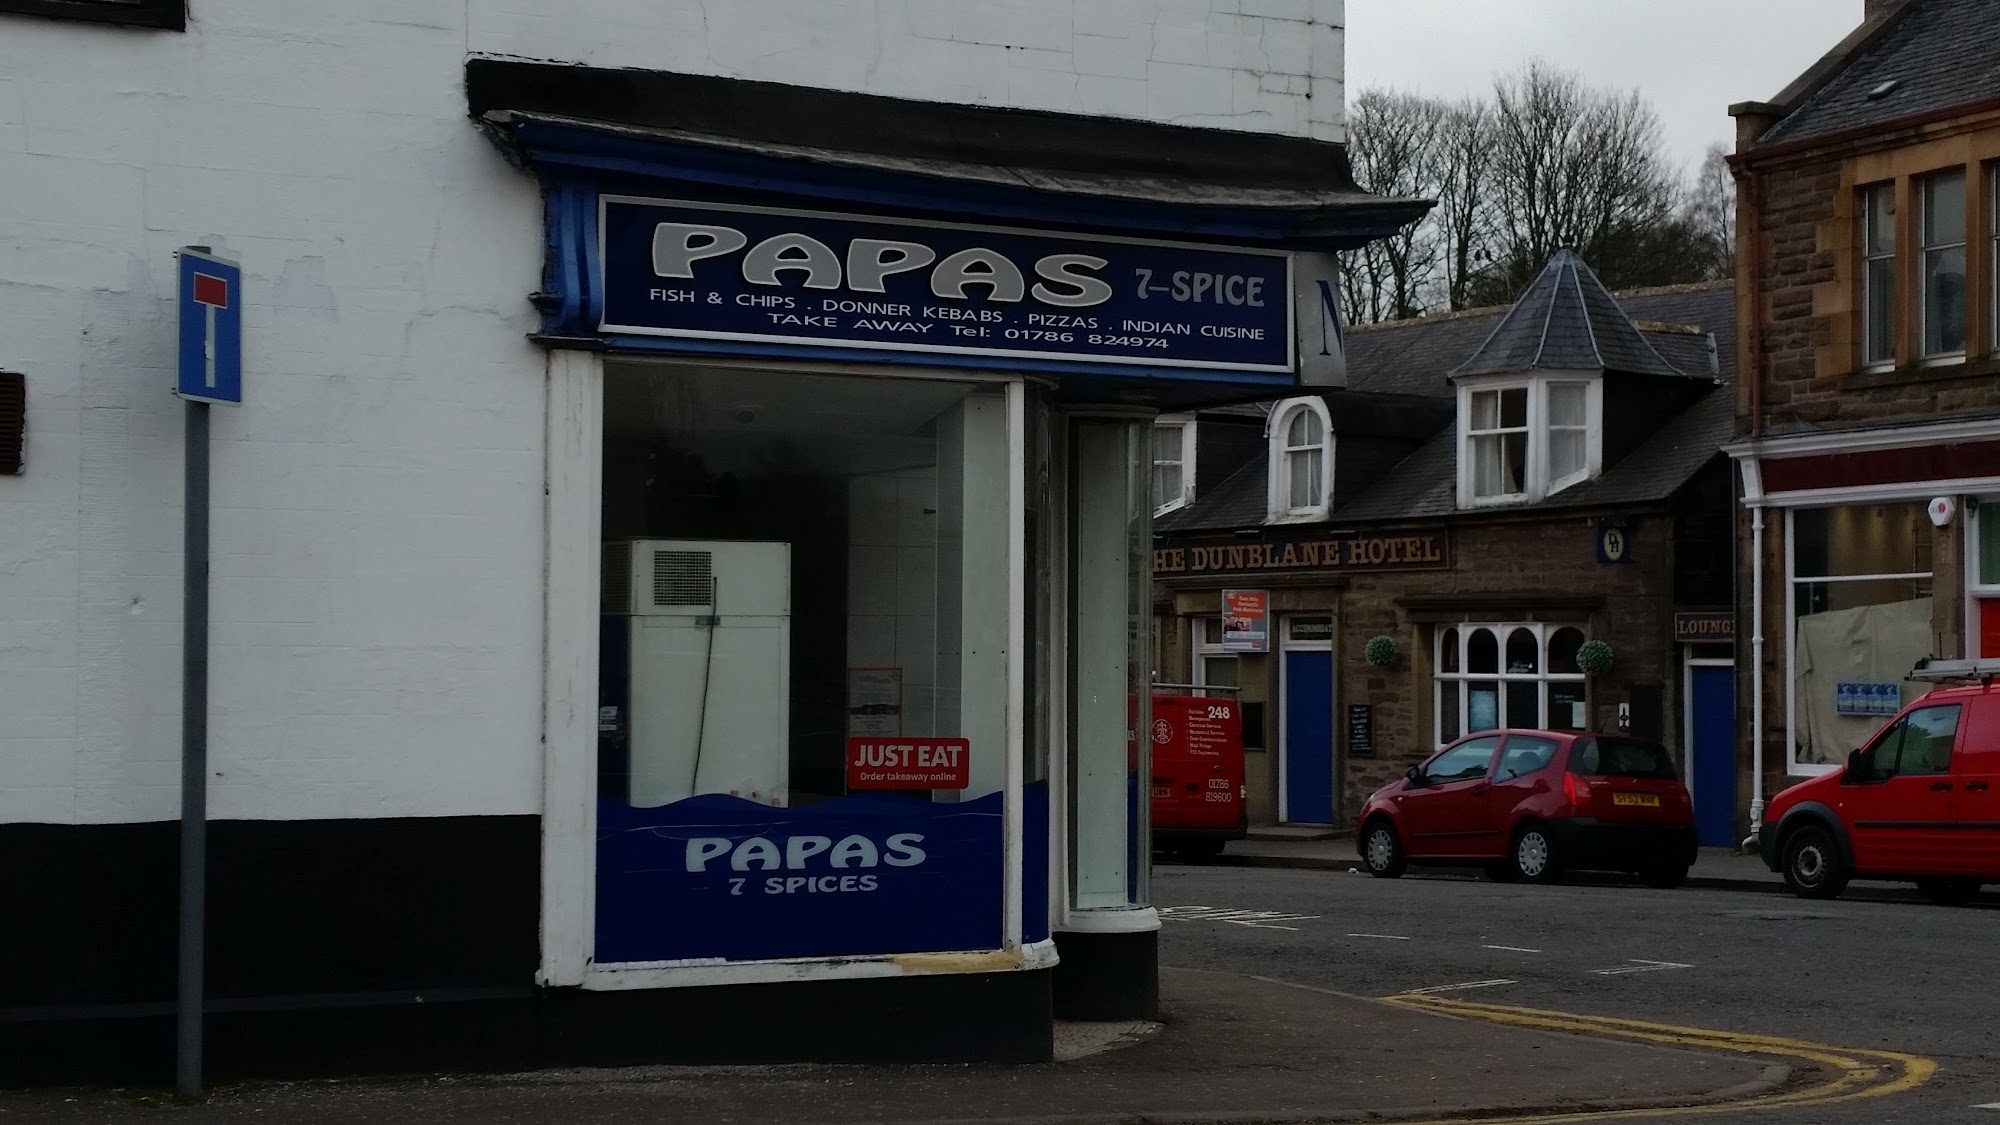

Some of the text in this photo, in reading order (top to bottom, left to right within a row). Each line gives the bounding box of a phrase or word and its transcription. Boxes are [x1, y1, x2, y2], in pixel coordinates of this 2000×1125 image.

[652, 222, 1112, 307] PAPAS
[1136, 268, 1265, 307] 7-SPICE
[650, 289, 1265, 340] FISH & CHIPS DONNER KEBABS PIZZAS INDIAN CUISINE
[767, 313, 1169, 349] TAKE AWAY Tel: 01786 824974
[1153, 536, 1441, 573] HE DUNBLANE HOTEL
[1208, 705, 1230, 719] 248
[854, 744, 962, 767] JUST EAT
[860, 771, 957, 783] Order takeaway online
[1208, 778, 1229, 789] 01786
[1205, 792, 1232, 803] 819600
[685, 833, 927, 873] PAPAS
[728, 875, 879, 896] 7 SPICES
